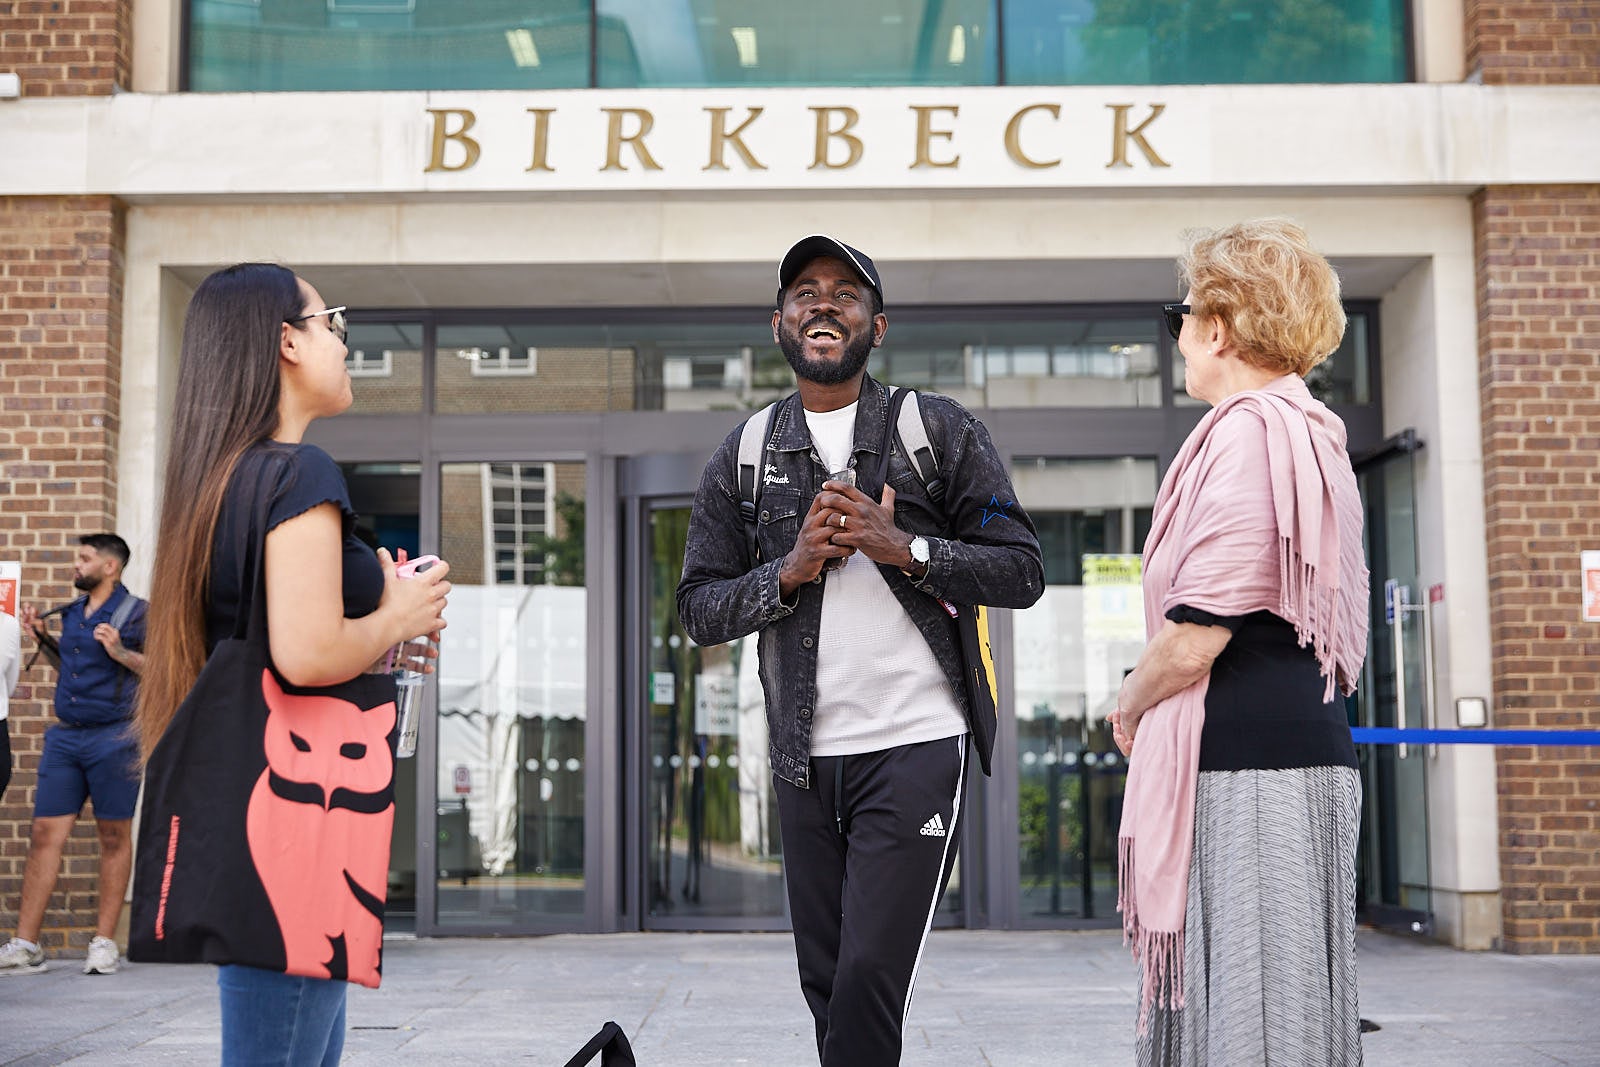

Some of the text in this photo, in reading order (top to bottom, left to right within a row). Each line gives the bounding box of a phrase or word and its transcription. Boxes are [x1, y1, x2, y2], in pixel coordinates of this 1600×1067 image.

[424, 104, 1171, 172] BIRKBECK
[167, 815, 180, 863] UNIVERSITY
[920, 827, 945, 837] adidas
